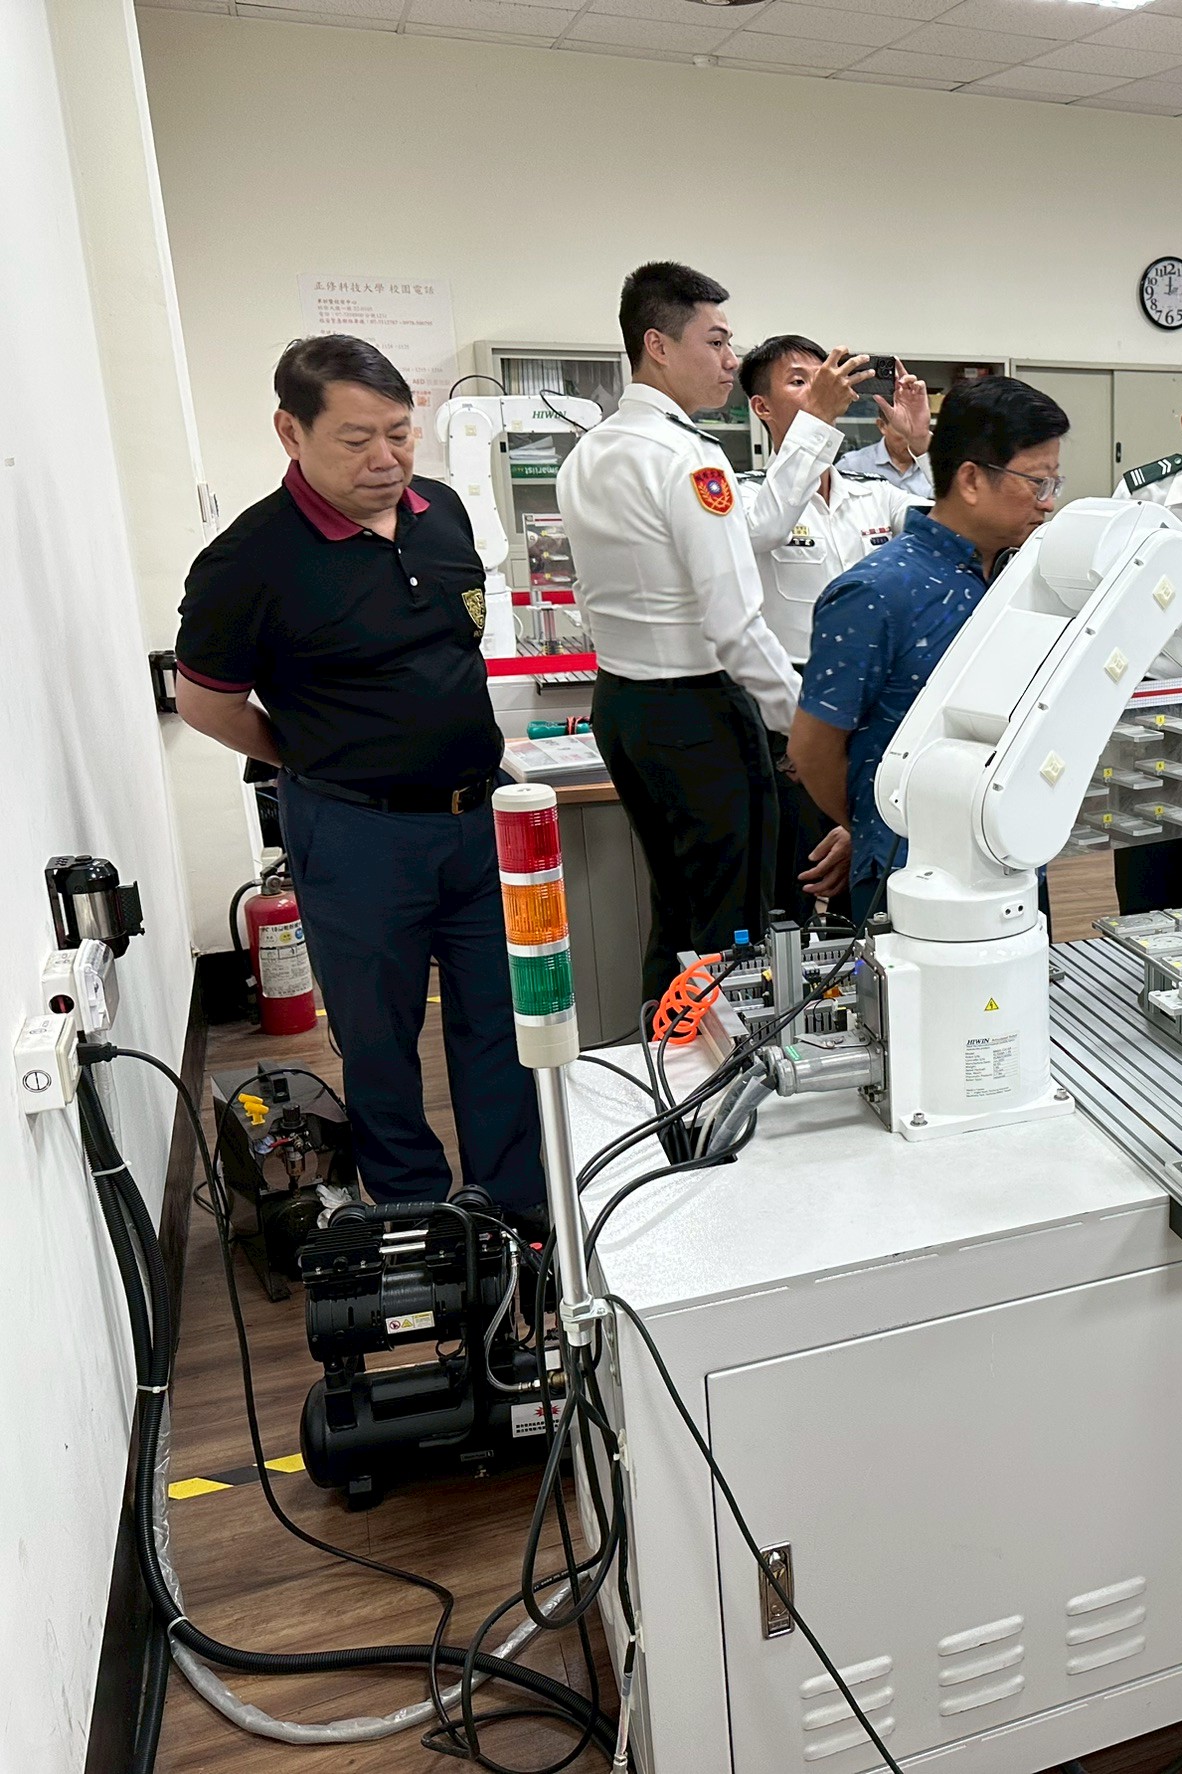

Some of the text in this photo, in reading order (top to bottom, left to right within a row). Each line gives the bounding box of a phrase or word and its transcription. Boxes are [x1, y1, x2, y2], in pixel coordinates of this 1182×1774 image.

[1163, 262, 1176, 276] 12
[1145, 285, 1154, 301] 9
[1150, 298, 1157, 311] 8
[1155, 310, 1163, 322] 7
[1165, 309, 1174, 325] 6
[1176, 309, 1182, 321] 5
